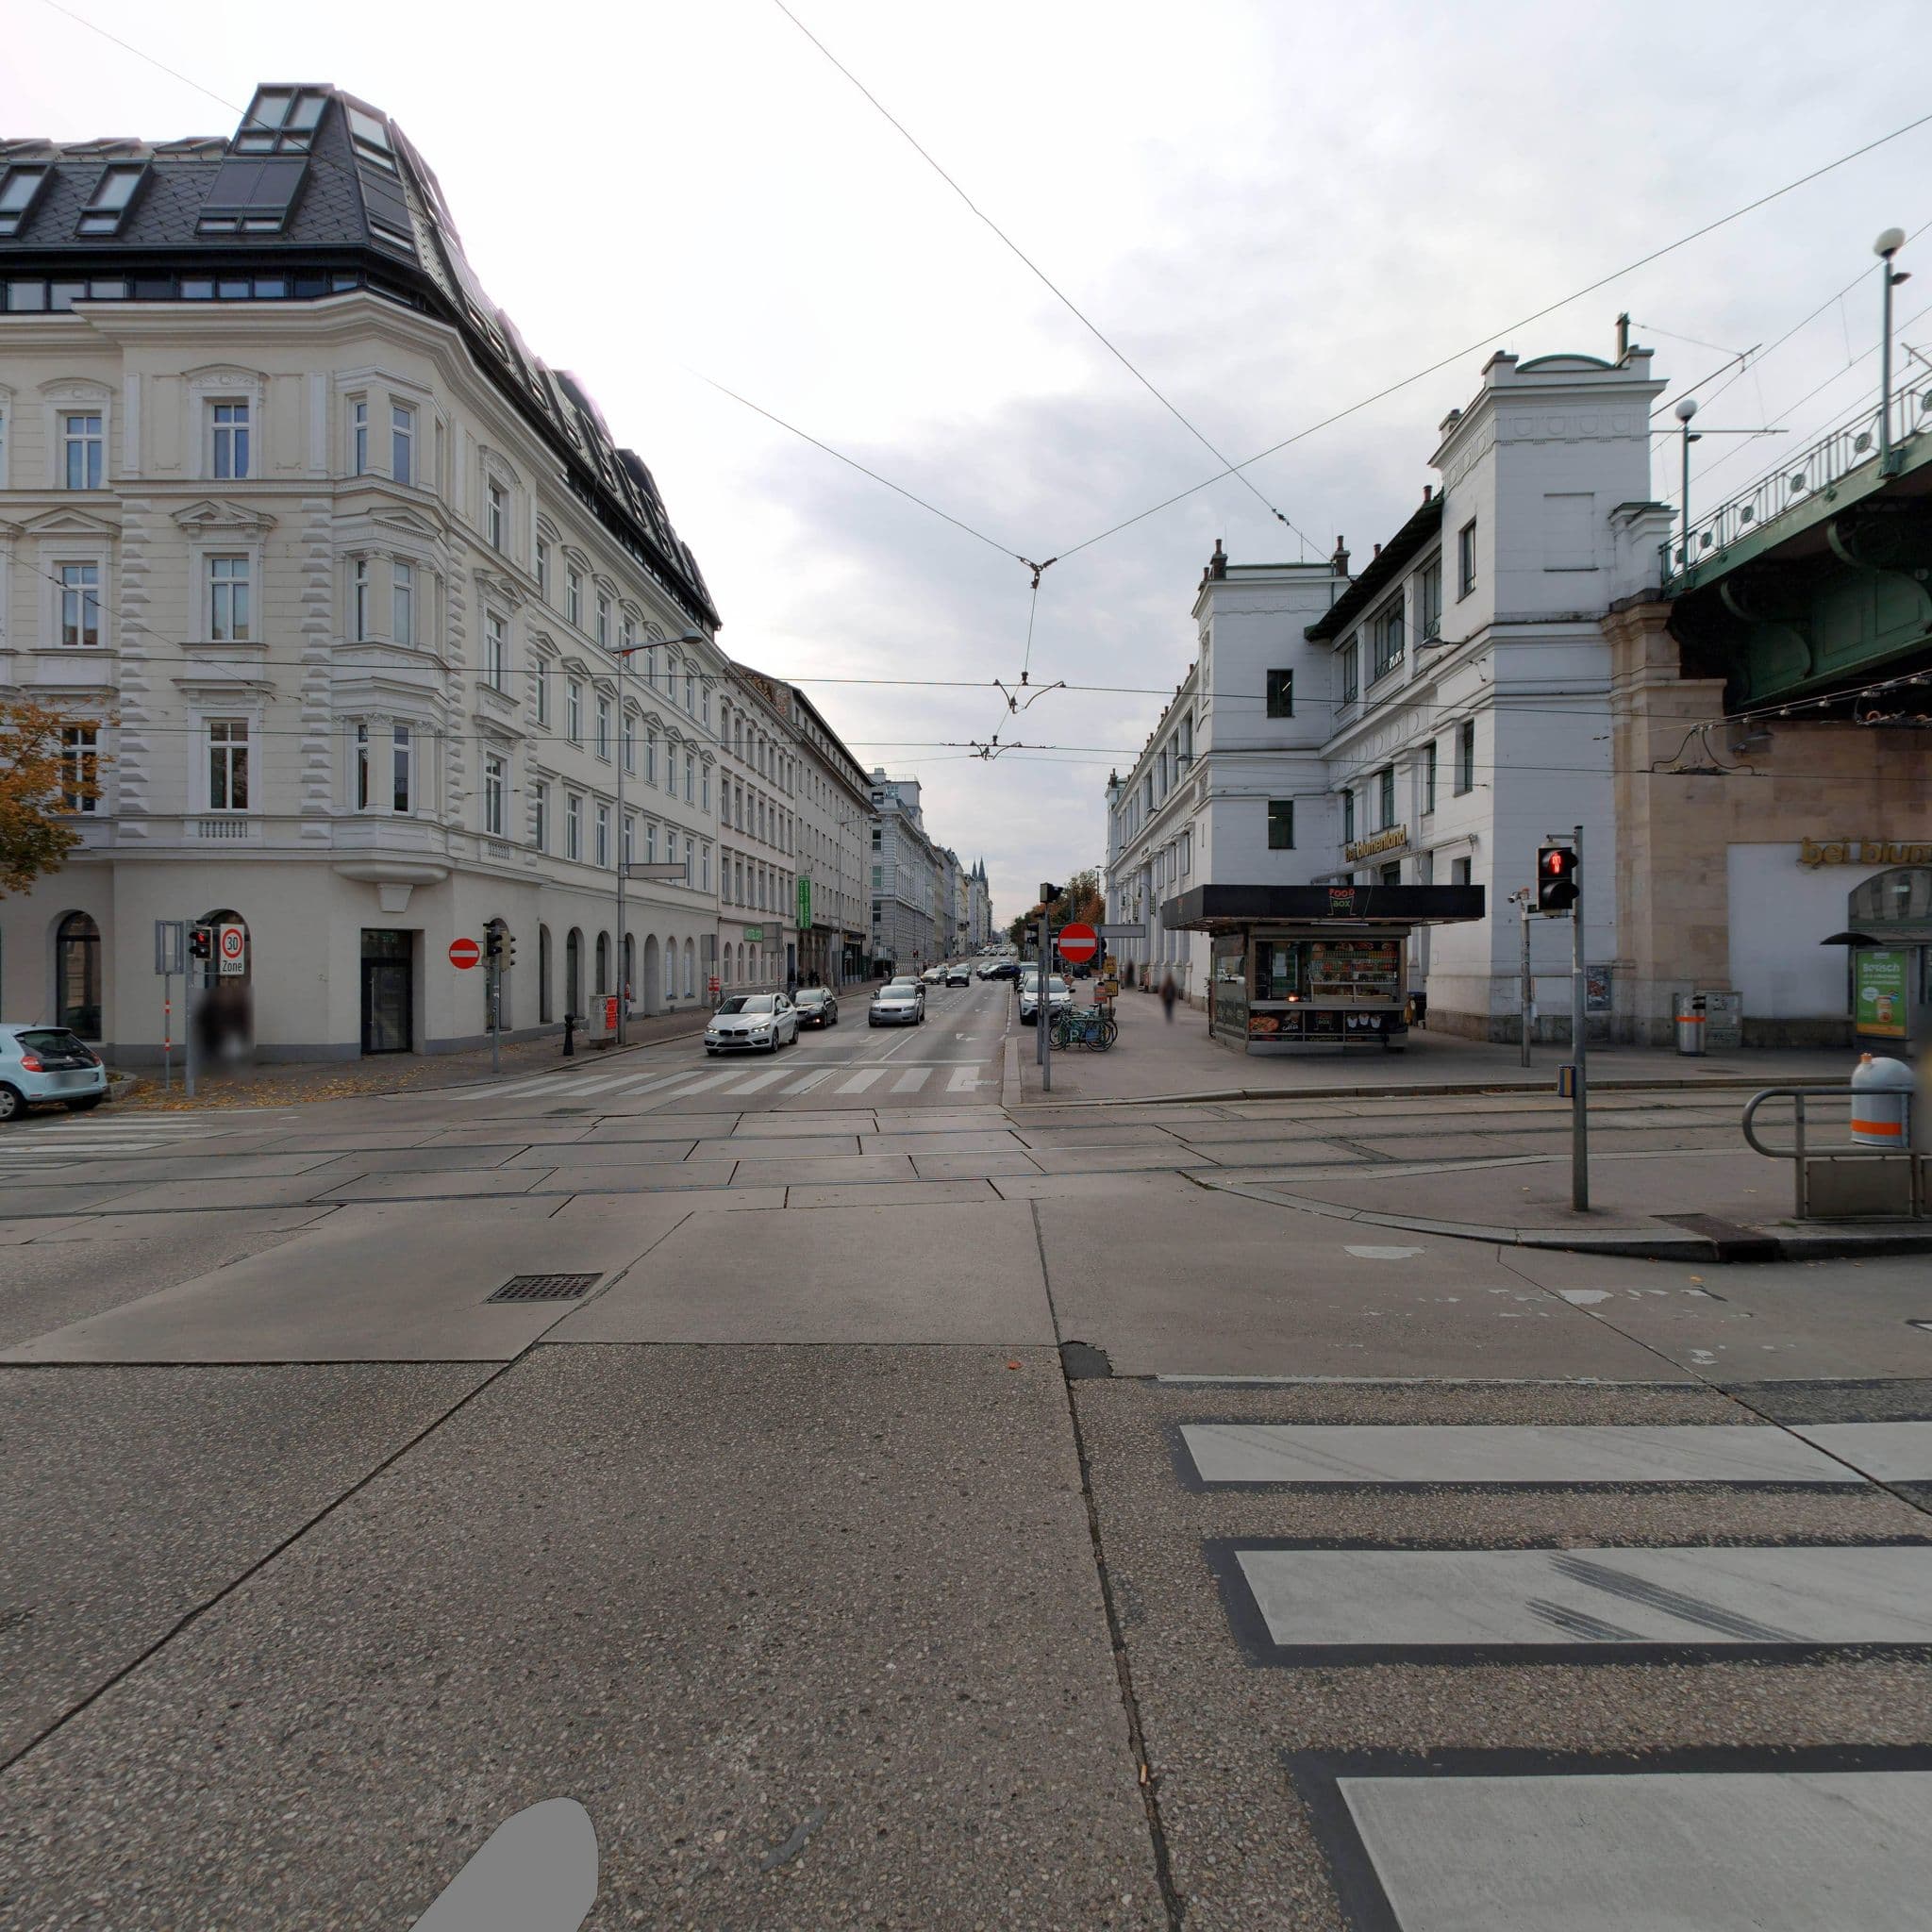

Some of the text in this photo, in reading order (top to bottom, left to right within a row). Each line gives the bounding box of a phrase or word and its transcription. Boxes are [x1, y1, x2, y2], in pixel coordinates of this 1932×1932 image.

[1357, 824, 1407, 858] blumenland
[1801, 837, 1850, 864] bei
[1328, 888, 1356, 897] FOOD
[226, 937, 239, 951] 30
[222, 960, 242, 973] Zone
